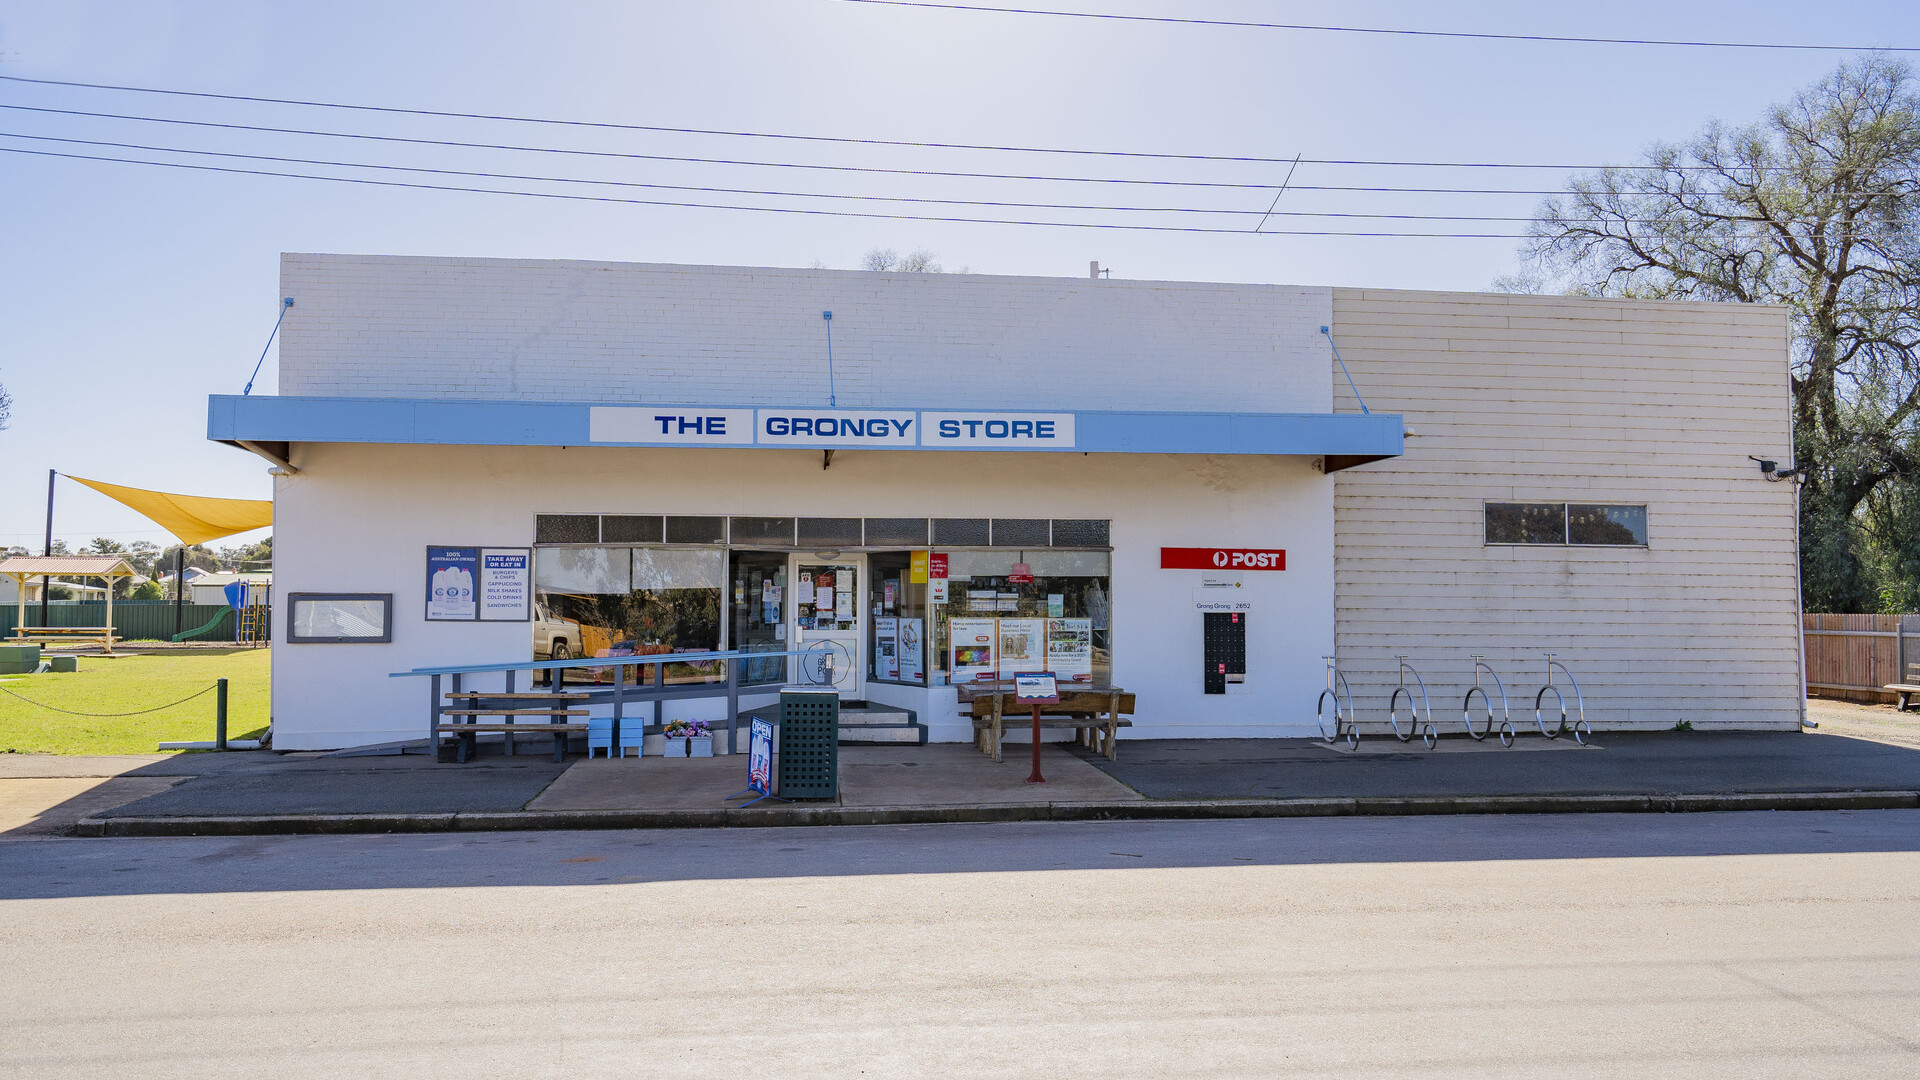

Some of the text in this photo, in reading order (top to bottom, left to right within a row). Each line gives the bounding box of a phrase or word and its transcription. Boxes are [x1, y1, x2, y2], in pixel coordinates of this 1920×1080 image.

[654, 415, 1055, 439] THE GRONGY STORE
[1231, 552, 1280, 567] POST
[1196, 602, 1213, 610] Grong
[1214, 602, 1231, 610] Grong
[751, 720, 772, 738] OPEN
